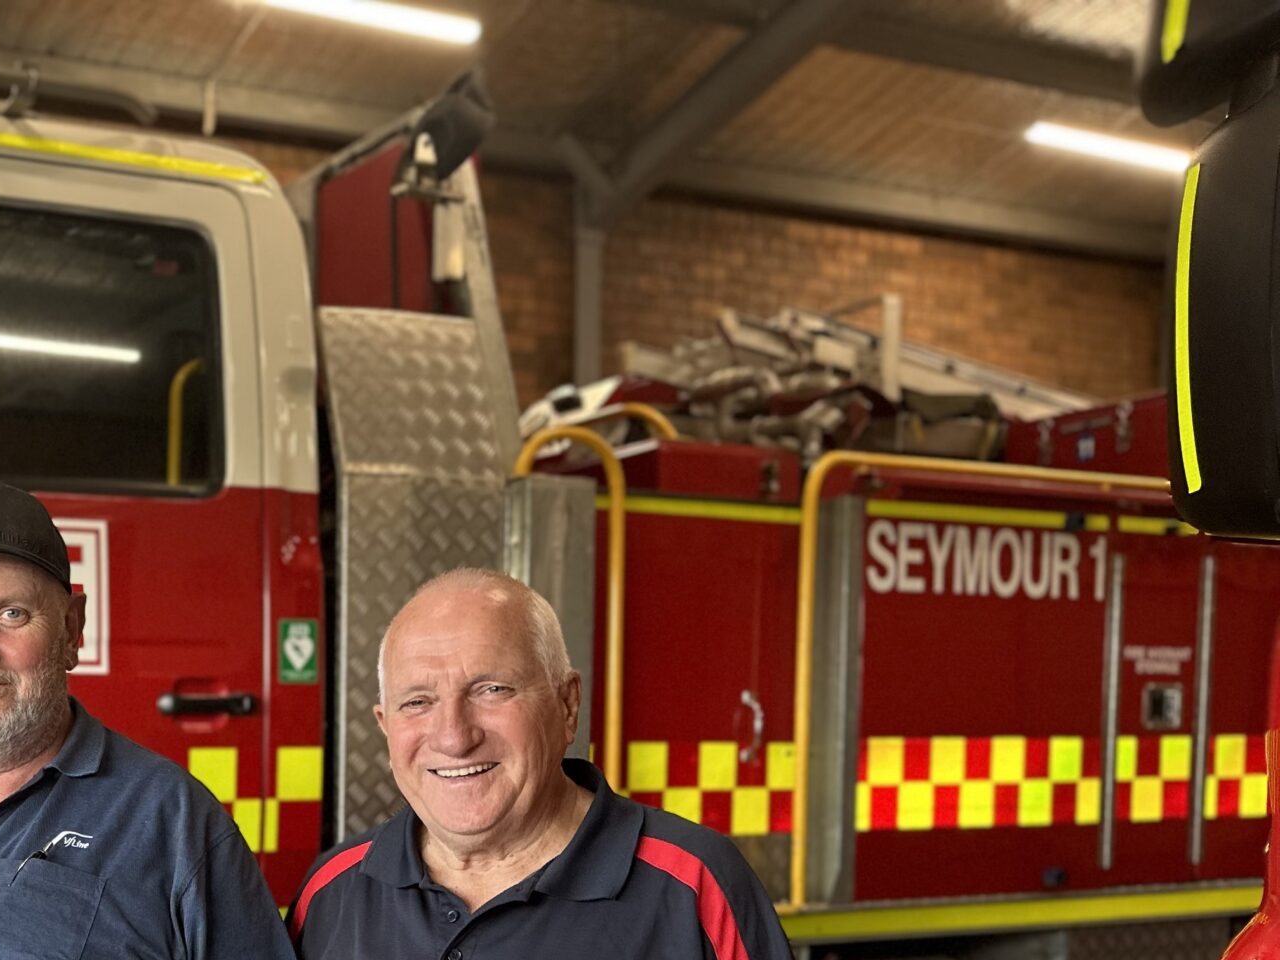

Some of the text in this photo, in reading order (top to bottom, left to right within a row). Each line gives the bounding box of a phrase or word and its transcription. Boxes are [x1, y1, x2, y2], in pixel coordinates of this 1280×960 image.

[866, 519, 1107, 602] SEYMOUR 1
[63, 836, 89, 849] V/Line
